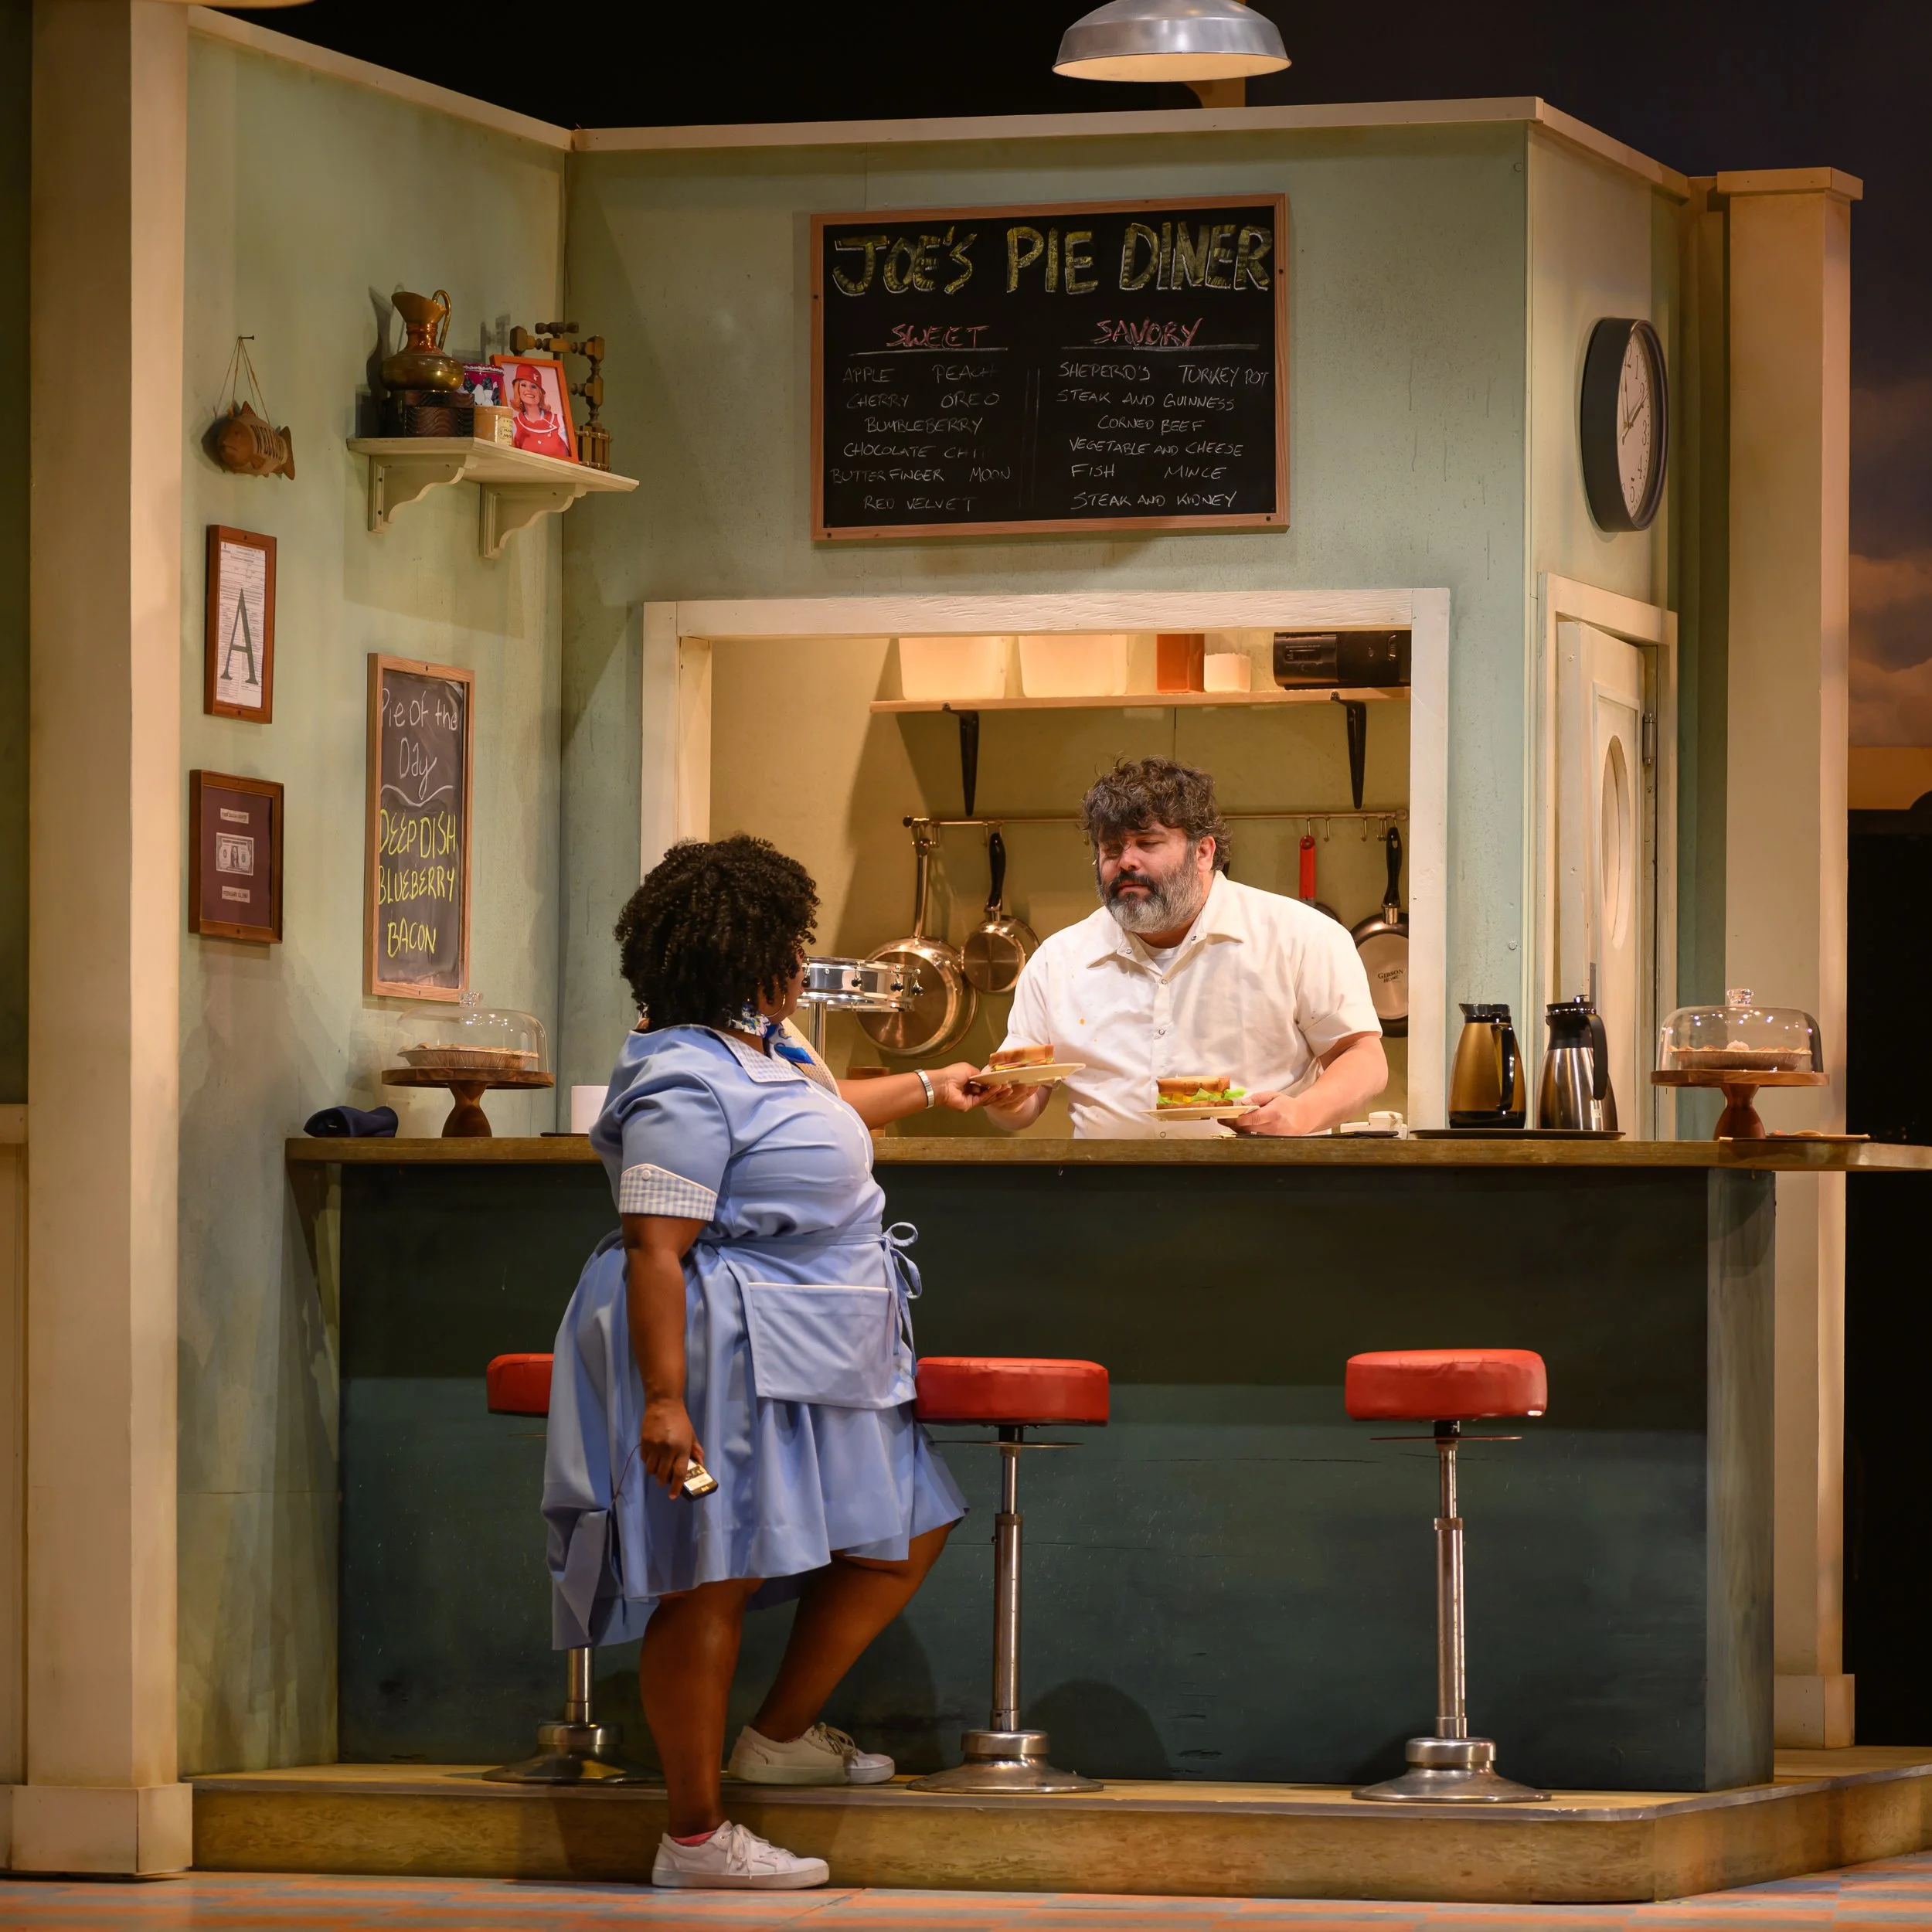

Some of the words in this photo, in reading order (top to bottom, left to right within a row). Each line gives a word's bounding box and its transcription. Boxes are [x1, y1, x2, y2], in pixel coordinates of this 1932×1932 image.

[832, 225, 978, 297] JOE'S
[1006, 226, 1098, 294] PIE
[1119, 220, 1274, 291] DINER
[886, 323, 990, 349] SWEET
[1090, 317, 1204, 347] SAVORY
[842, 367, 896, 383] APPLE
[932, 364, 998, 383] PEACH
[1178, 364, 1240, 386] TURKEY
[1244, 368, 1269, 387] POT
[846, 393, 910, 410] CHERRY
[940, 390, 1000, 409] OREO
[1056, 389, 1111, 404] STEAK
[1121, 392, 1155, 407] AND
[1163, 393, 1234, 411] GUINNESS
[864, 417, 983, 434] BUMBLEBERRY
[1097, 414, 1155, 430] CORNED
[1161, 419, 1206, 436] BEEF
[843, 441, 936, 459] CHOCOLATE
[1069, 437, 1151, 455] VEGETABLE
[1154, 444, 1179, 456] AND
[1185, 440, 1243, 457] CHEESE
[969, 466, 1011, 483] MOON
[1071, 463, 1114, 478] FISH
[1164, 465, 1227, 480] MINCE
[864, 495, 895, 511] RED
[906, 496, 979, 512] VELVET
[1070, 492, 1131, 510] STEAK
[1138, 494, 1165, 507] AND
[1177, 491, 1237, 508] KIDNEY
[220, 587, 259, 685] A
[434, 699, 457, 730] the
[399, 736, 437, 800] Day
[379, 808, 417, 856] DEEP
[420, 810, 457, 860] DISH
[378, 865, 455, 906] BLUEBERRY
[387, 917, 437, 958] BACON
[1377, 969, 1403, 979] GIBSON
